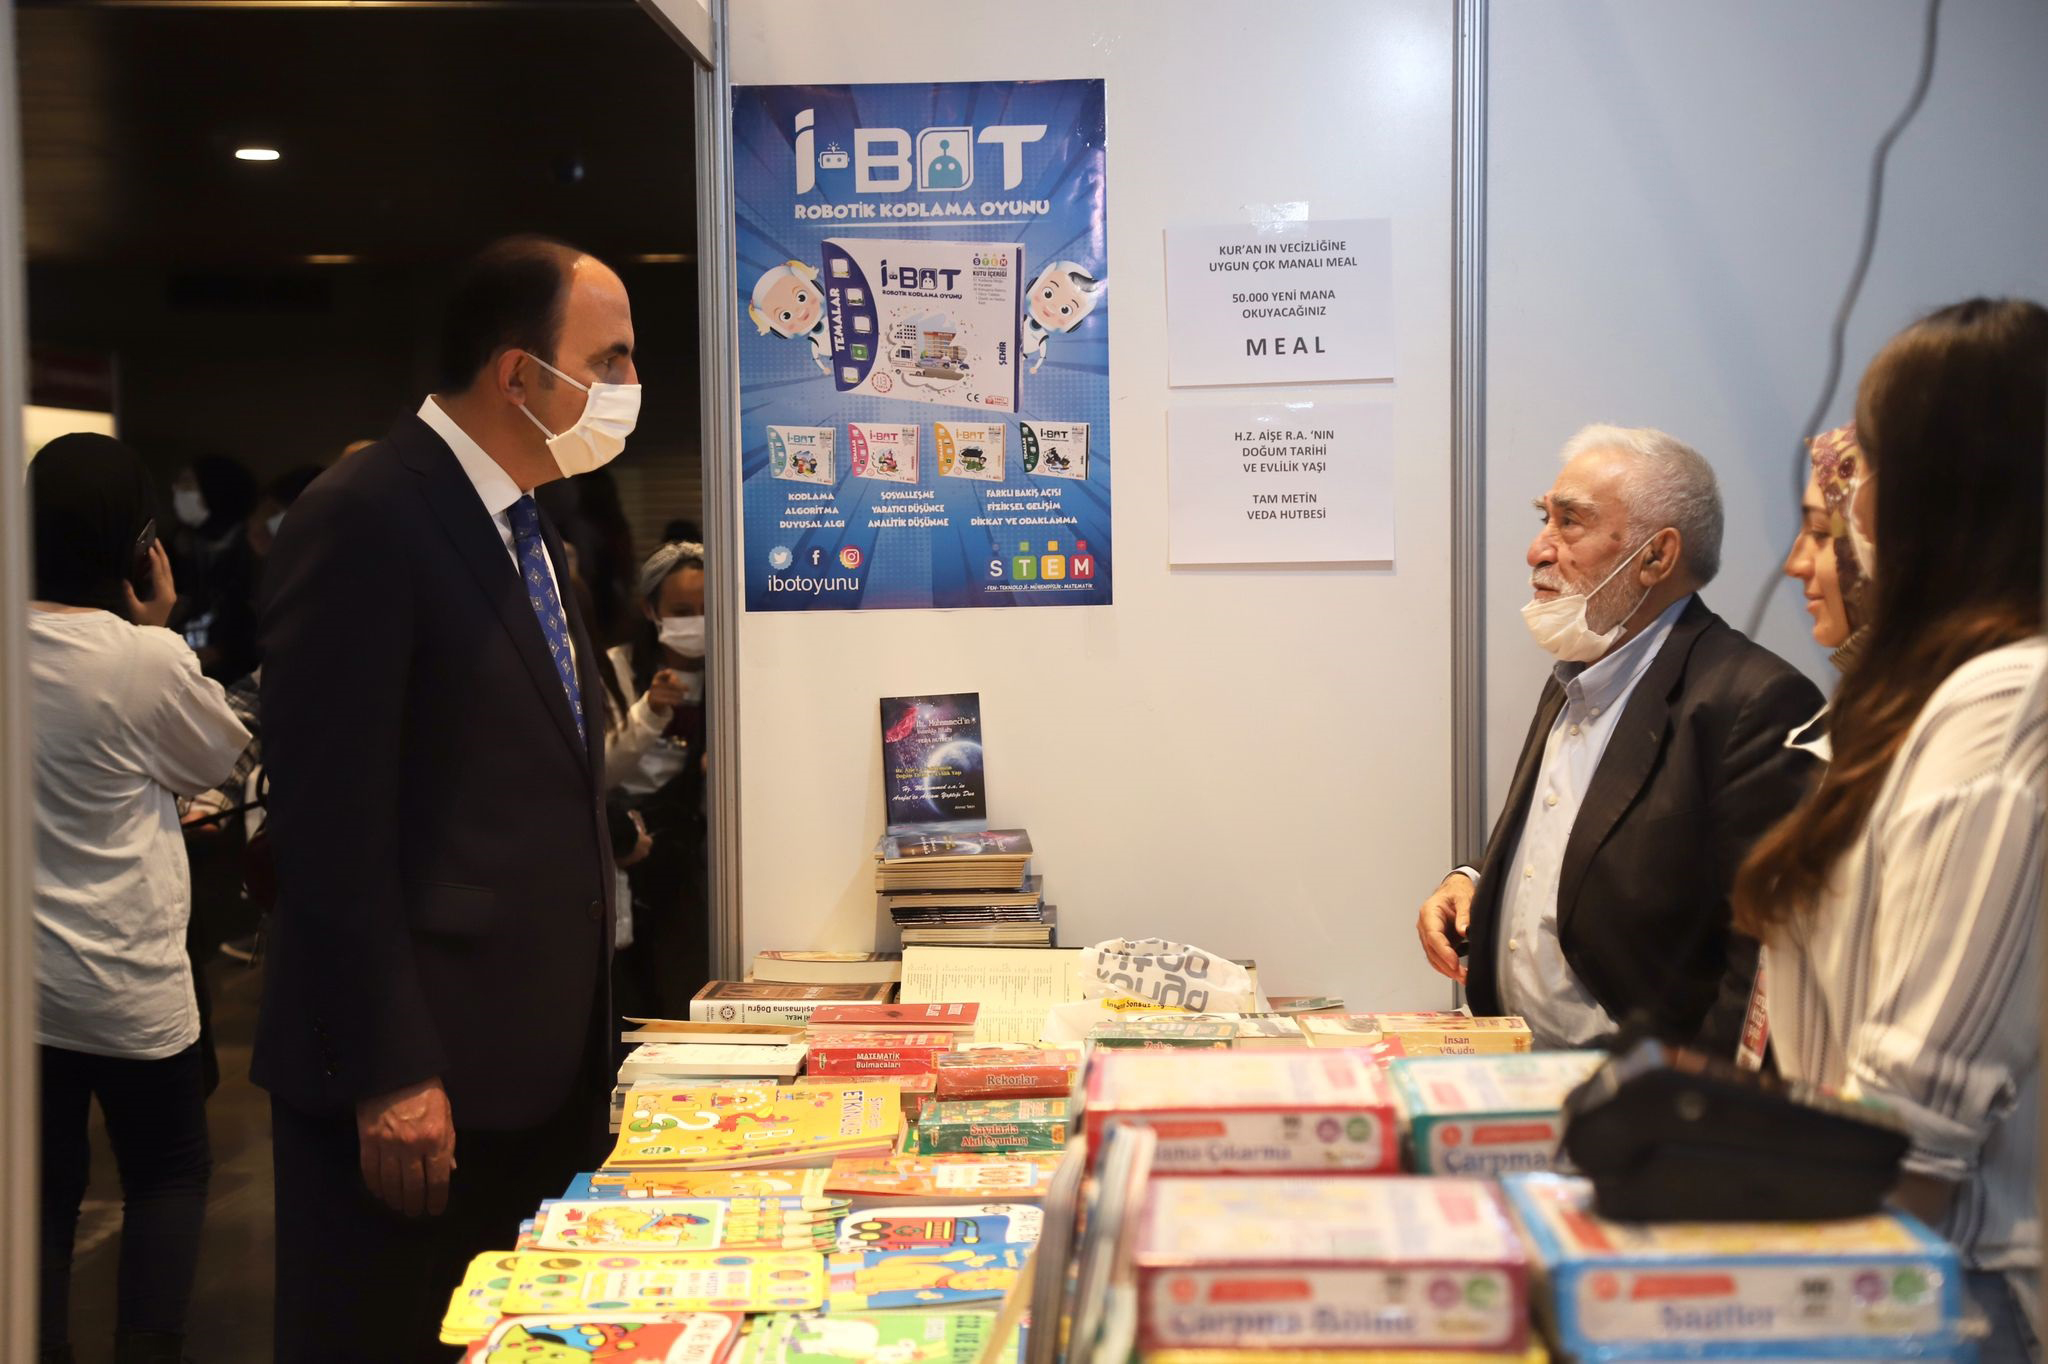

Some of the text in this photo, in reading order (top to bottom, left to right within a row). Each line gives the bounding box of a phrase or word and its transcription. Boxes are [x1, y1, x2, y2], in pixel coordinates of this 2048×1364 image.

[795, 200, 1050, 220] ROBOTİK KODLAMA OYUNU
[1265, 244, 1277, 254] IN
[1280, 239, 1347, 253] VECİZLİĞİNE
[1209, 256, 1357, 272] UYGUN ÇOK MANALI MEAL
[1232, 289, 1336, 304] 50.000 YENİ MANA
[1242, 304, 1327, 319] OKUYACAĞINIZ
[830, 288, 845, 352] TEMALAR
[1235, 431, 1256, 442] H.Z.
[1258, 428, 1284, 444] AİŞE
[1285, 430, 1307, 441] R.A.
[1242, 443, 1327, 457] DOĞUM TARİHİ
[1243, 460, 1326, 474] VE EVLİLİK YAŞI
[788, 493, 835, 501] KODLAMA
[987, 488, 1062, 498] FARKLI BAKIŞ AÇISI
[1253, 491, 1317, 504] TAM METİN
[785, 505, 839, 515] ALGORİTMA
[871, 503, 945, 514] YARATICI DÜŞÜNCE
[987, 501, 1061, 512] FİZİKSEL GELİŞİM
[1247, 508, 1326, 520] VEDA HUTBESİ
[780, 520, 845, 529] DUYUSAL ALGI
[868, 517, 949, 528] ANALİTİK DÜŞÜNME
[971, 516, 1003, 526] DİKKAT
[768, 574, 859, 595] ibotoyunu
[747, 1004, 771, 1014] Doğru
[1444, 1035, 1470, 1045] İnsan
[856, 1052, 900, 1060] MATEMATİK
[856, 1061, 901, 1069] Bulmacaları
[986, 1075, 1037, 1085] Rekorlar
[970, 1124, 1019, 1137] Sayılarla
[961, 1136, 982, 1147] Akıl
